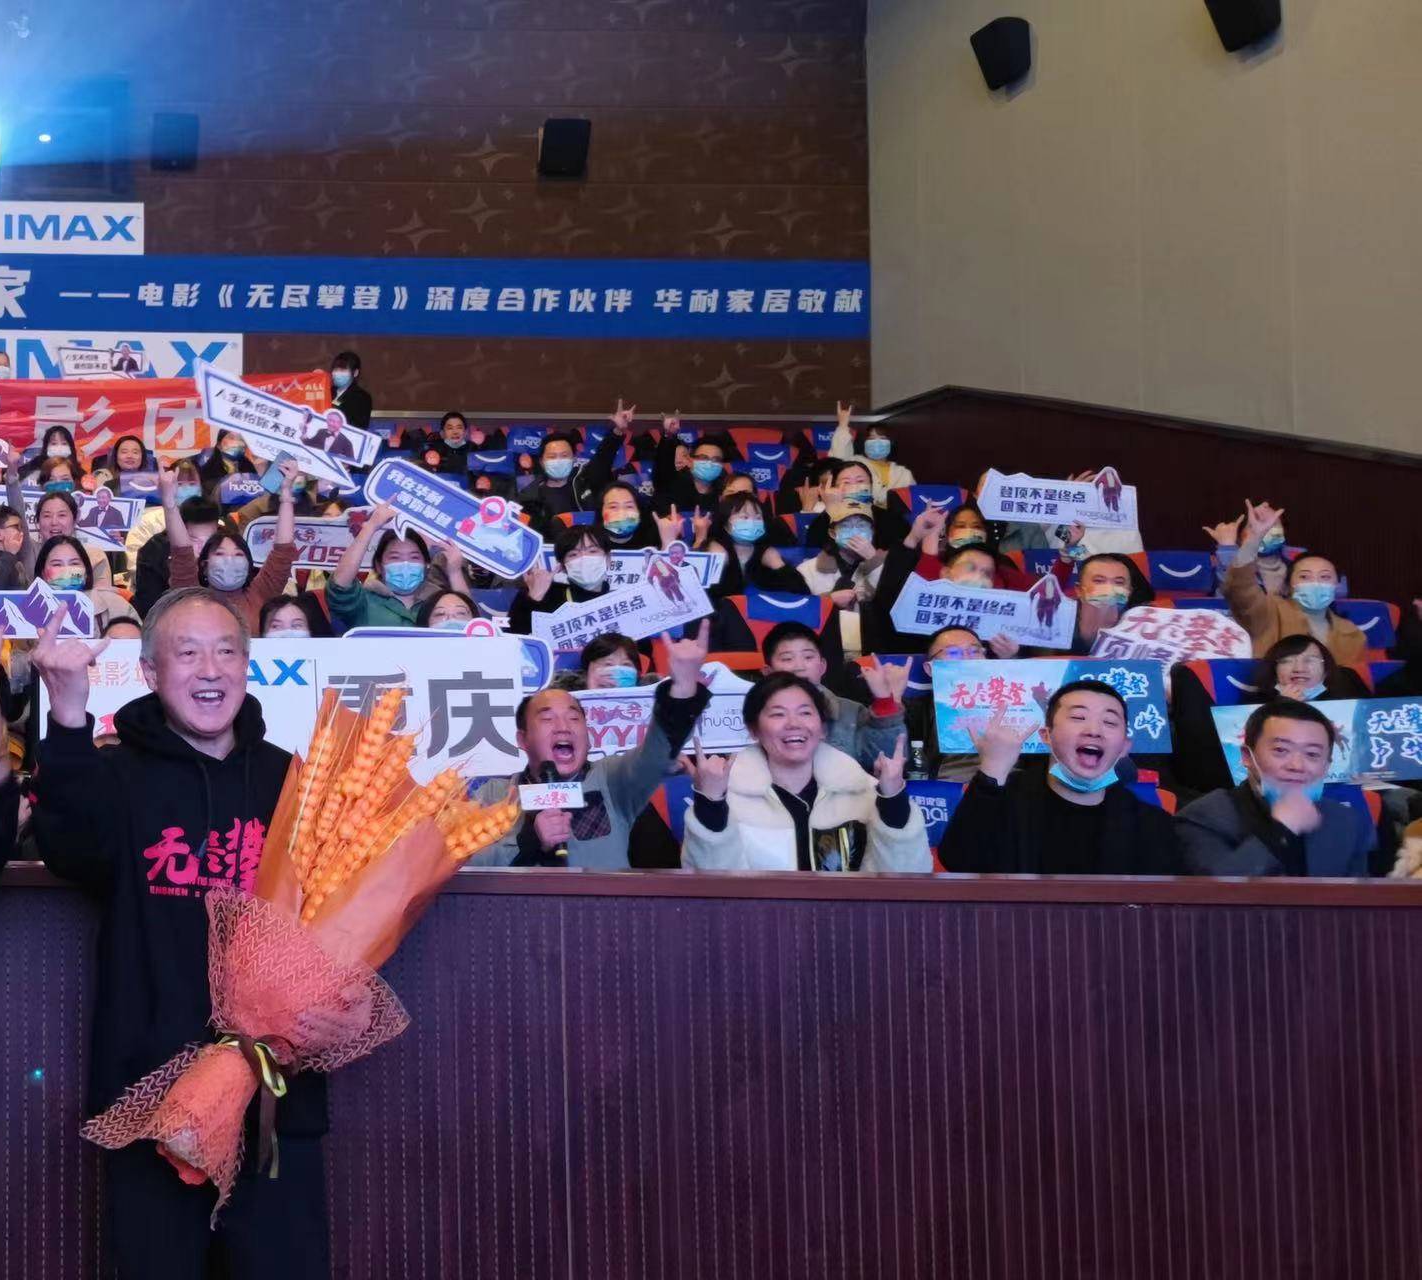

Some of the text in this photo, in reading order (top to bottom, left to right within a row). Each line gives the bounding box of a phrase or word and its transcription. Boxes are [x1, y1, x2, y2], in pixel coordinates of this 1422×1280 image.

[4, 213, 136, 241] IMAX
[654, 288, 864, 315] 华耐家居敬献
[999, 485, 1086, 504] 登顶不是终点
[1000, 502, 1058, 516] 回家才是
[550, 594, 647, 639] 登顶不是终点
[917, 592, 1017, 616] 登顶不是终点
